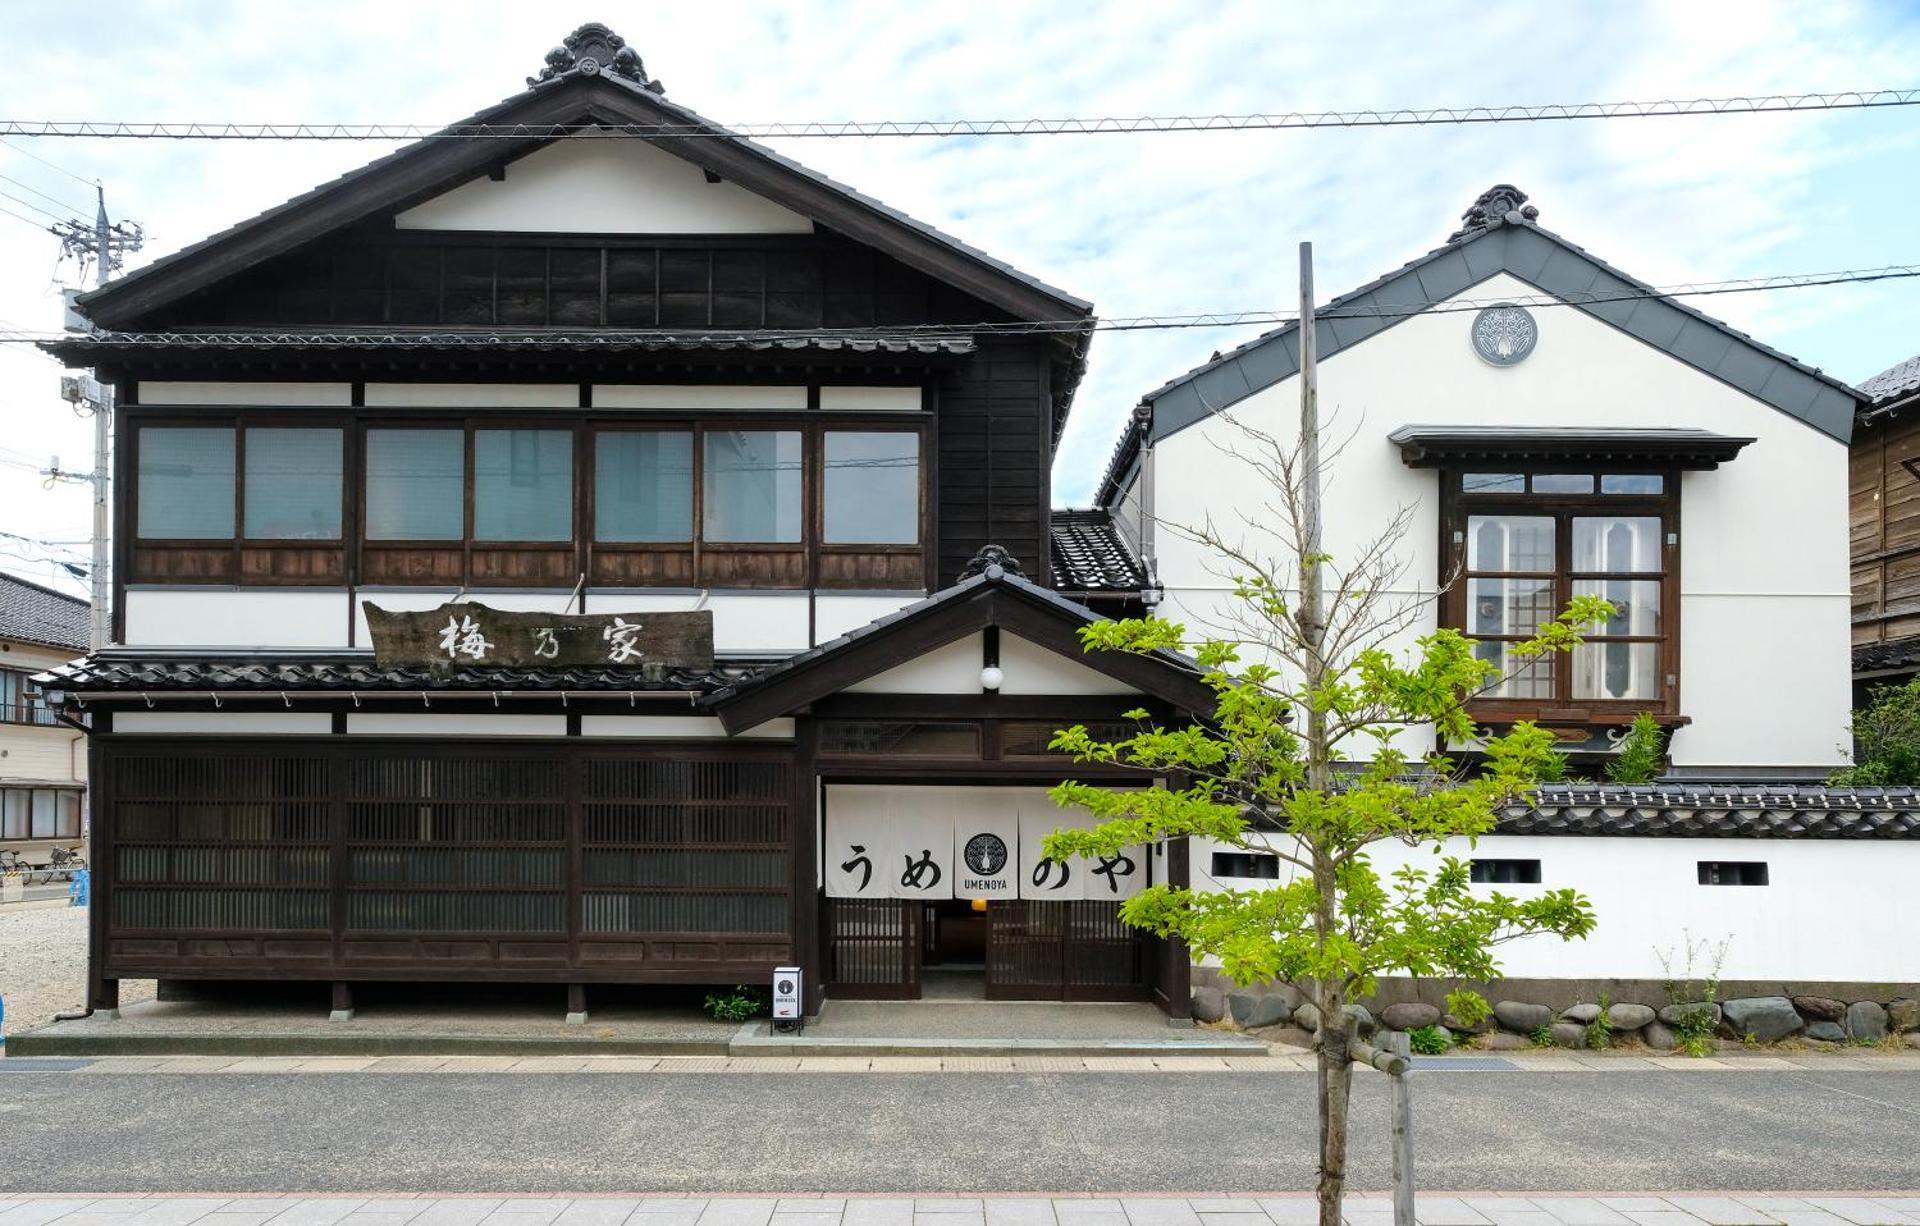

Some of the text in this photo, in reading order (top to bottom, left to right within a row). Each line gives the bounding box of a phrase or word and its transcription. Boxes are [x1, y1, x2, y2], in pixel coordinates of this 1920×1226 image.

[439, 615, 644, 663] 梅乃家
[964, 879, 1007, 890] UMENOYA
